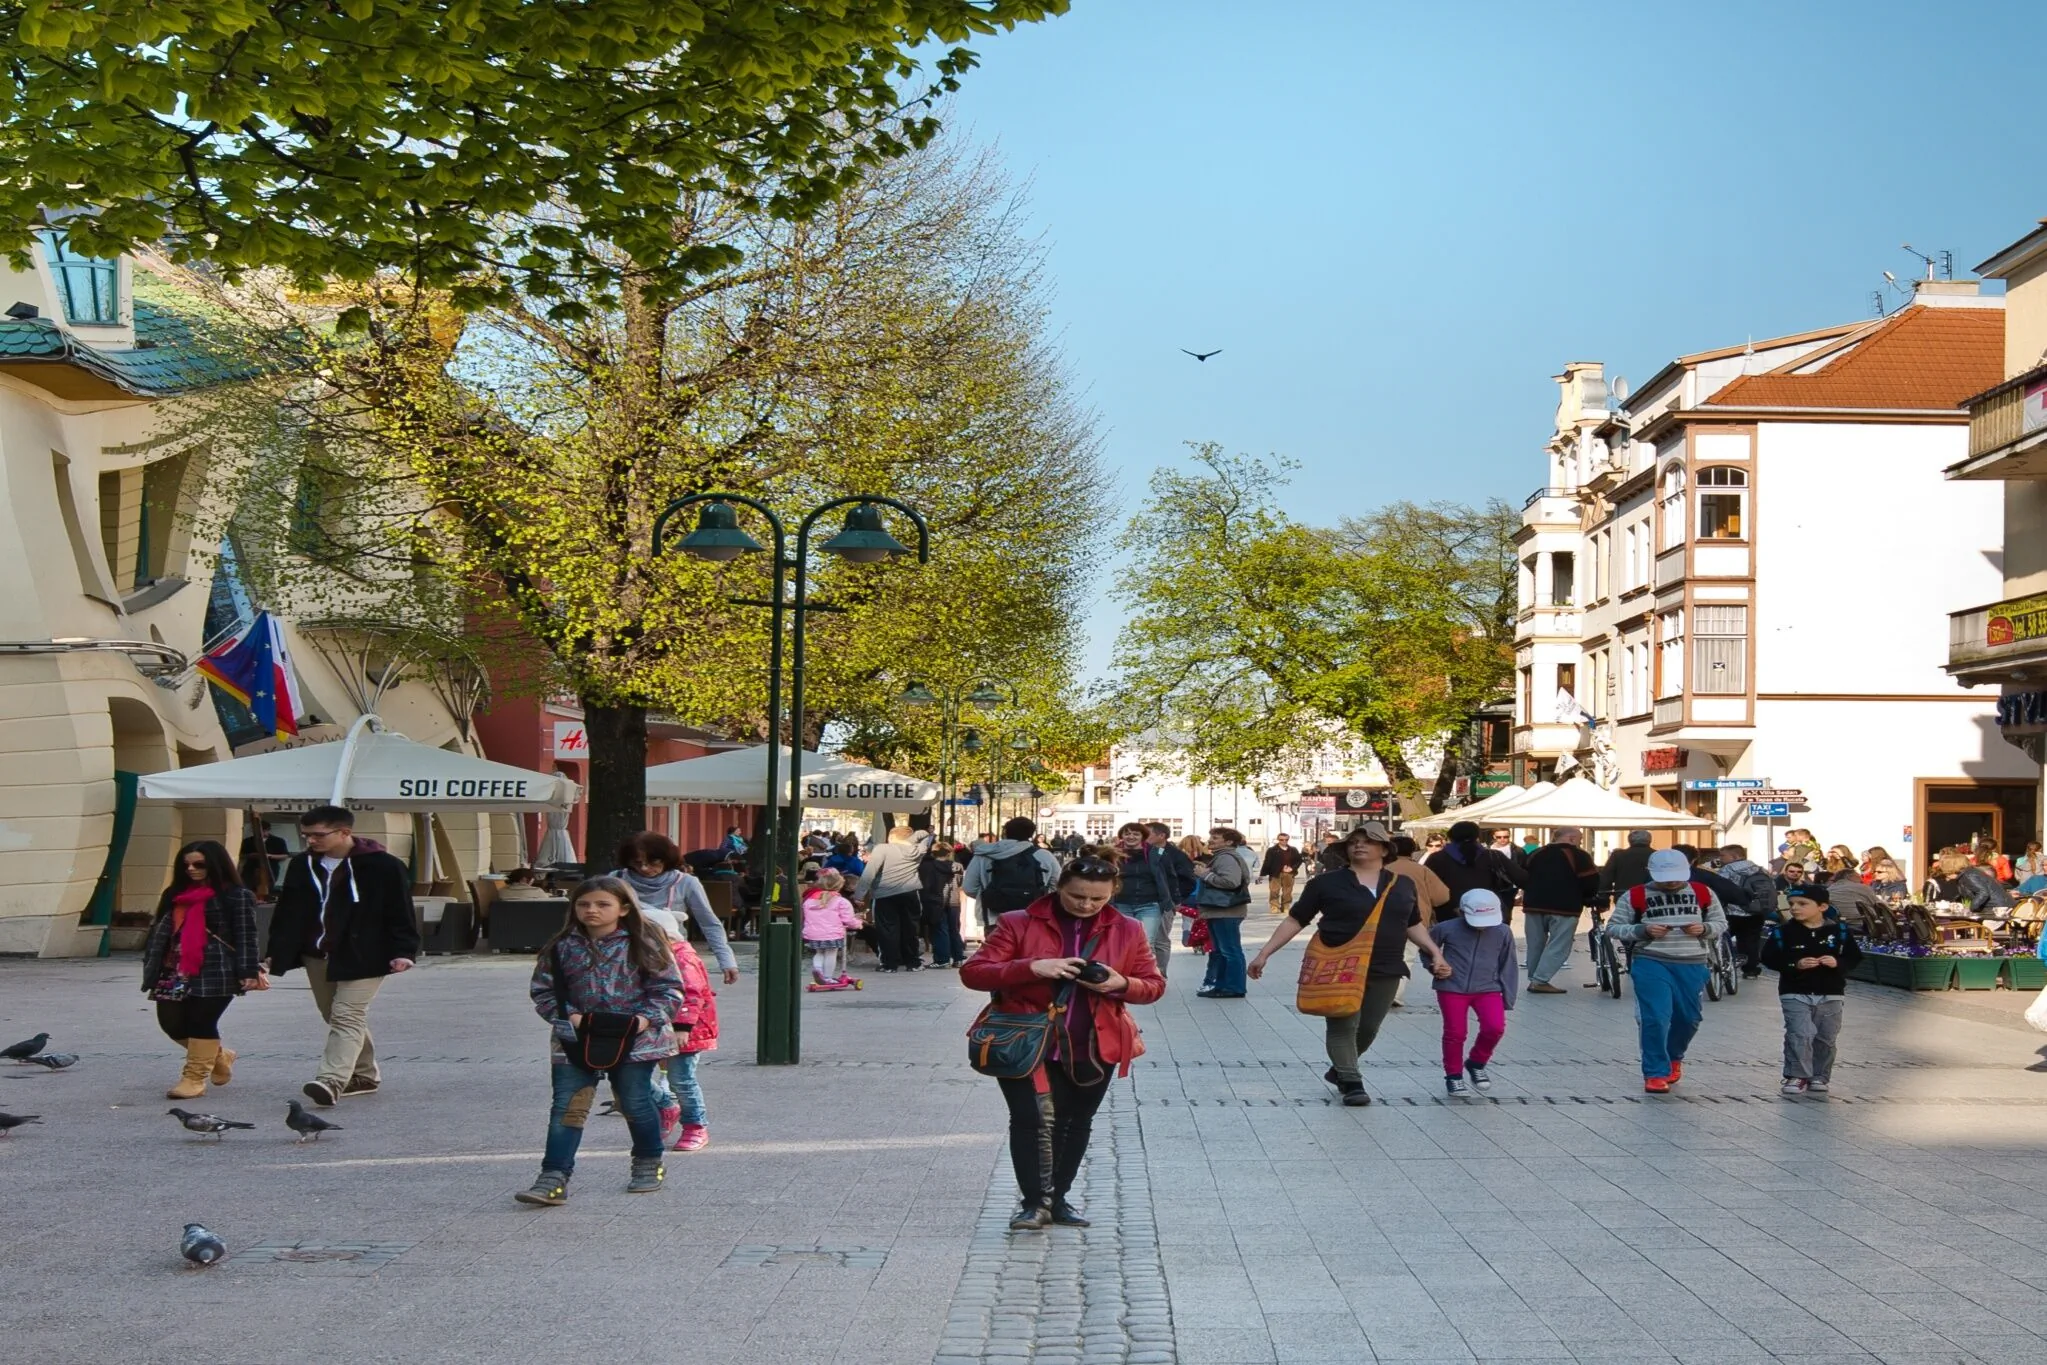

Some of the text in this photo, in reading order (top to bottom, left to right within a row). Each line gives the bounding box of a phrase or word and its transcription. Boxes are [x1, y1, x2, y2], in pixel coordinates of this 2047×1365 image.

[399, 780, 528, 798] SO! COFFEE
[807, 783, 915, 799] SO! COFFEE
[1647, 906, 1698, 918] NORTH POLE
